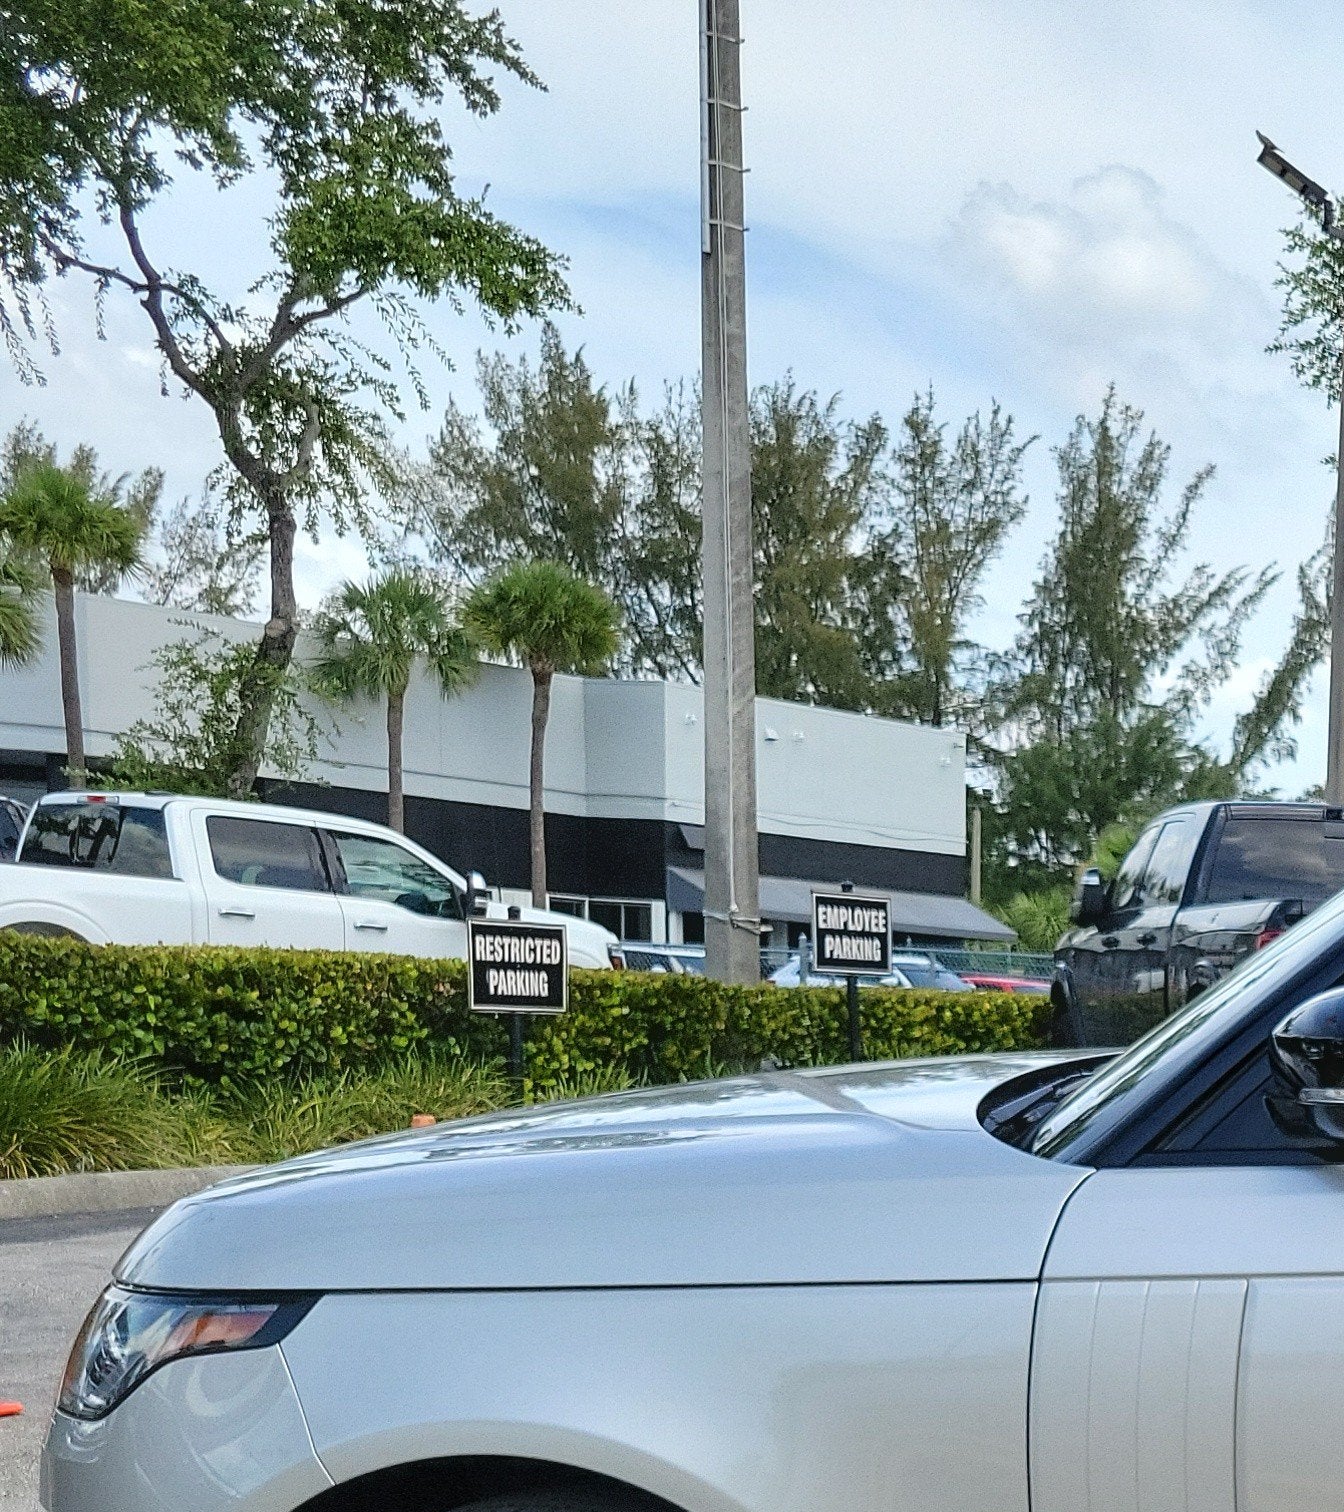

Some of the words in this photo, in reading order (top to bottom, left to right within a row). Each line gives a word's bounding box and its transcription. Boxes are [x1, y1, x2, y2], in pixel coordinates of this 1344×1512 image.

[817, 903, 887, 934] EMPLOYEE
[474, 933, 561, 966] RESTRICTED
[824, 934, 882, 962] PARKING
[488, 968, 549, 998] PARKING
